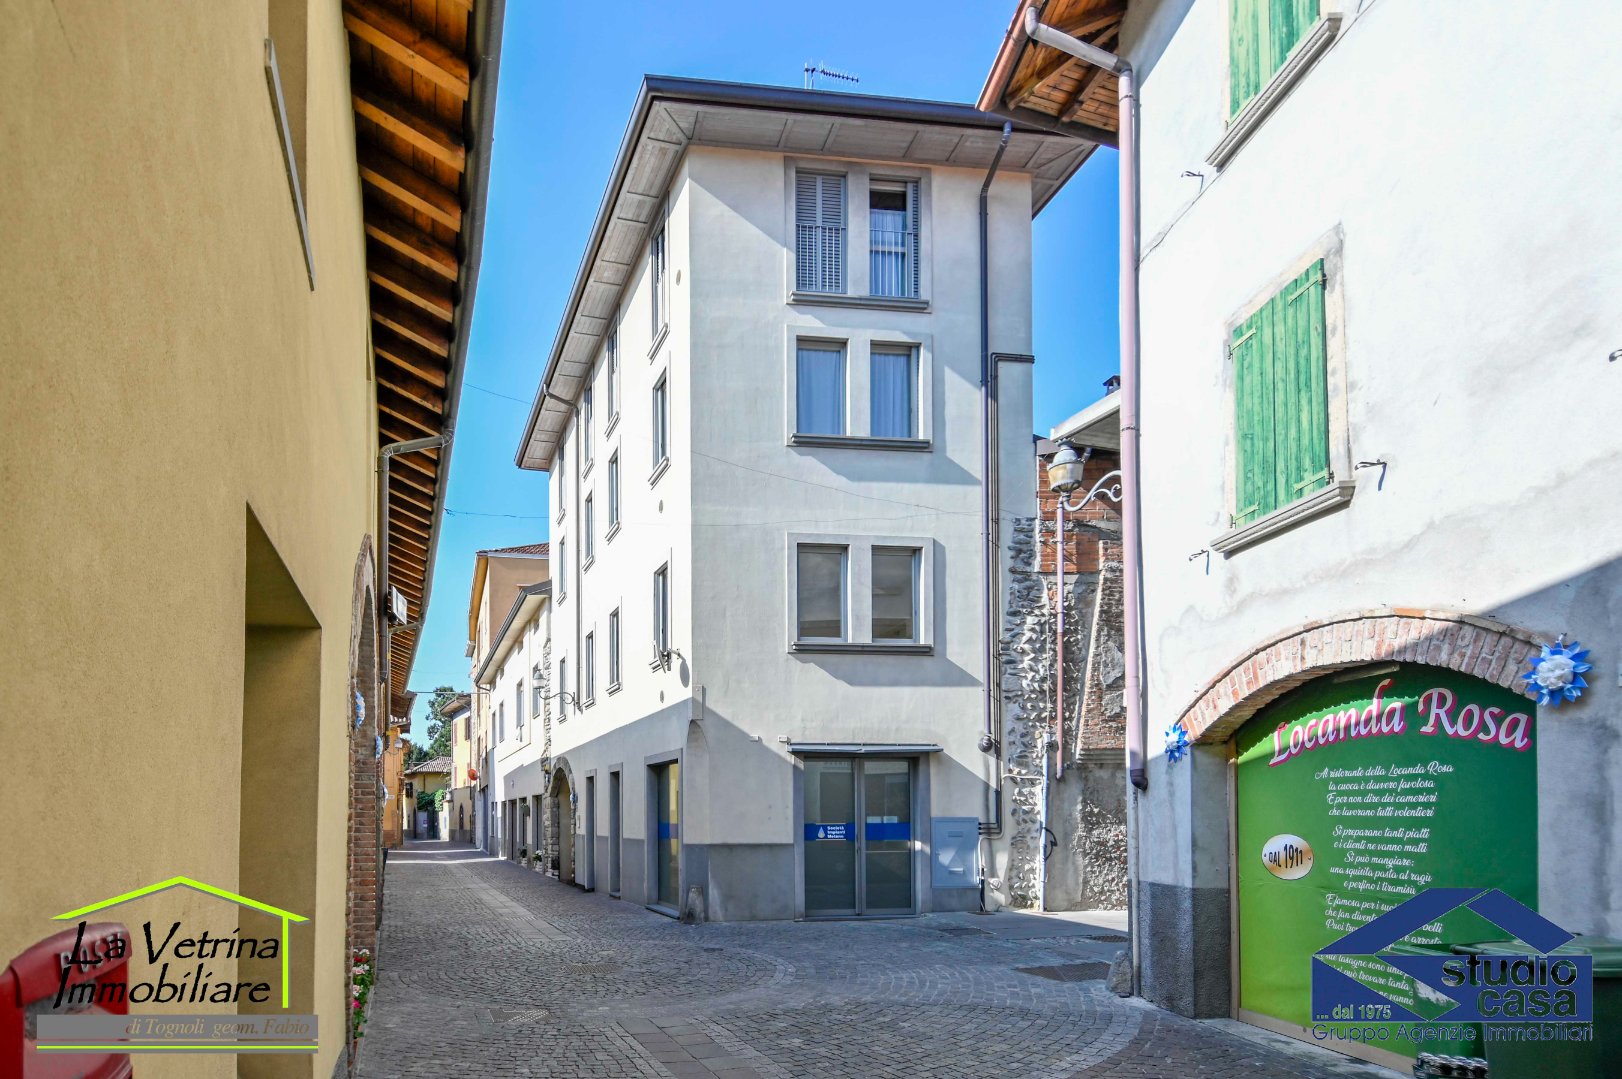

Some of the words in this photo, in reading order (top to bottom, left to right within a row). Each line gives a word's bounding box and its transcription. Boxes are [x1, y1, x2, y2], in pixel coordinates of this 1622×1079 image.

[1269, 679, 1407, 767] Locanda
[1417, 687, 1533, 752] Rosa
[1314, 767, 1329, 779] Al
[1330, 766, 1364, 778] ristorante
[1365, 766, 1385, 776] della
[1388, 763, 1426, 777] Locanda
[1427, 760, 1454, 775] Rosa
[1328, 781, 1336, 790] la
[1366, 780, 1397, 790] davvero
[1398, 778, 1435, 792] favolosa
[1334, 795, 1348, 806] per
[1363, 793, 1380, 803] dire
[1381, 792, 1395, 803] dei
[1396, 792, 1438, 803] camerieri
[1328, 806, 1341, 816] che
[1342, 807, 1375, 816] lavorano
[1376, 806, 1394, 816] tutti
[1394, 806, 1435, 817] volentieri
[1342, 828, 1382, 838] preparano
[1384, 827, 1404, 837] tanti
[1404, 827, 1430, 841] piatti
[1343, 839, 1366, 849] clienti
[1377, 843, 1402, 852] vanno
[1403, 842, 1428, 853] matti
[1268, 850, 1281, 867] DAL
[1283, 843, 1303, 868] 1911
[1355, 854, 1370, 864] può
[1329, 866, 1344, 874] una
[1345, 866, 1373, 877] squisita
[1374, 868, 1398, 880] pasta
[1398, 870, 1409, 880] al
[1411, 873, 1433, 886] ragù
[1348, 880, 1375, 892] perfino
[1333, 896, 1360, 907] famosa
[1360, 901, 1376, 911] per
[1325, 908, 1337, 917] che
[1337, 908, 1350, 920] fan
[1338, 955, 1367, 969] lasagne
[1367, 962, 1385, 971] sono
[1358, 971, 1387, 985] trovare
